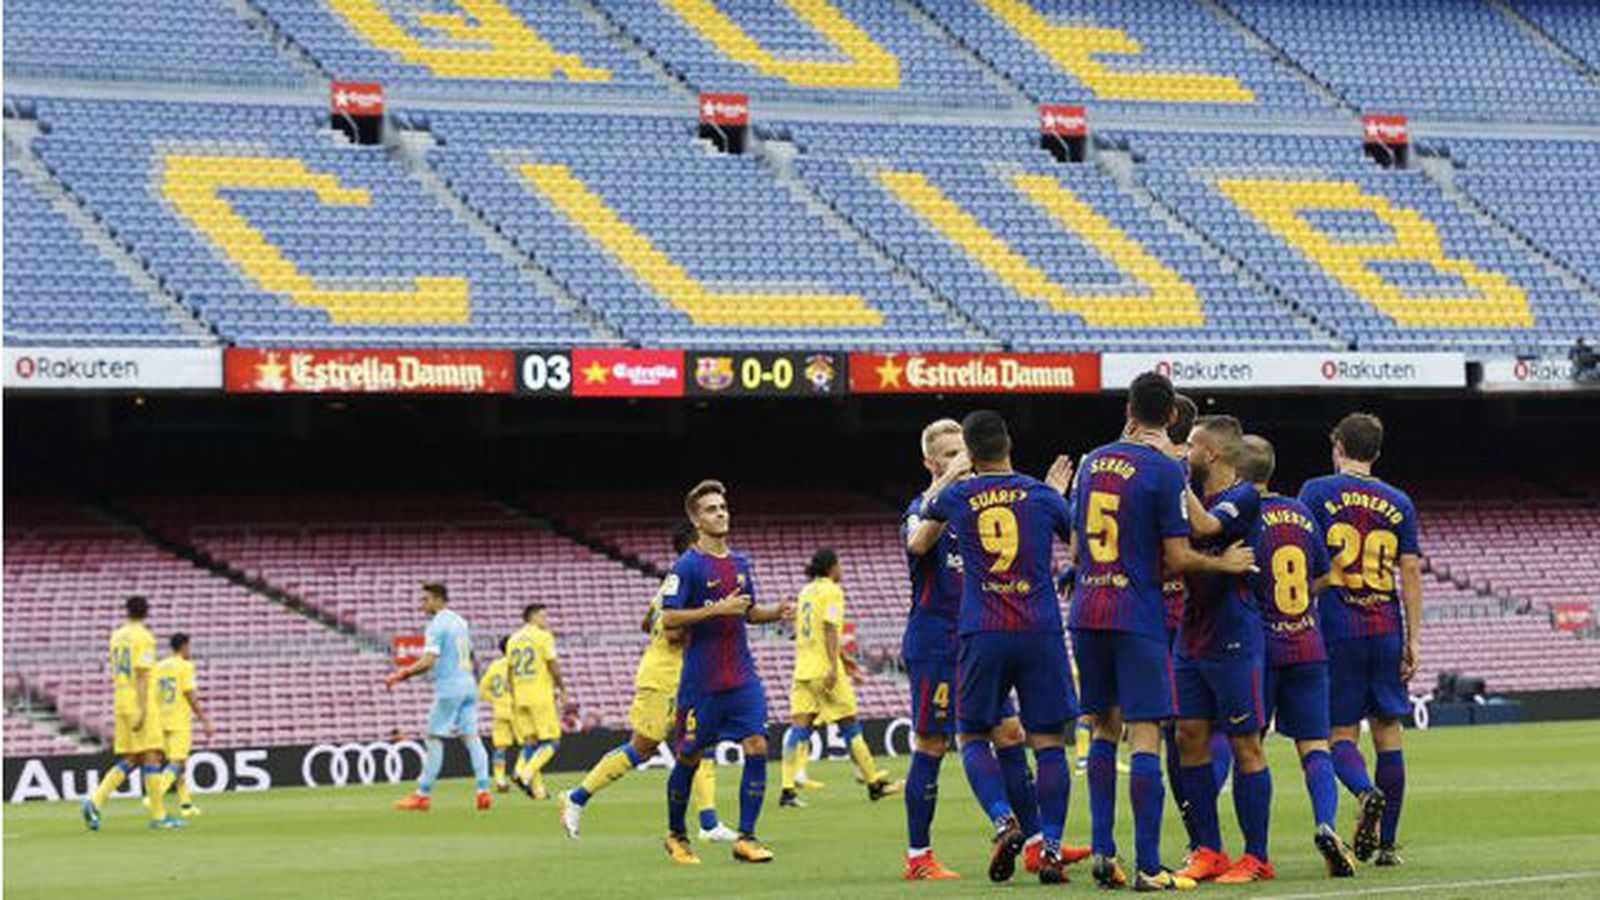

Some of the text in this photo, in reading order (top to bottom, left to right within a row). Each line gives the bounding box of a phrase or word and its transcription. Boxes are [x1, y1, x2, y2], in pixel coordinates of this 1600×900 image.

[38, 356, 139, 379] Rakuten
[289, 352, 484, 390] Estrella Damm
[522, 355, 571, 391] 03
[740, 358, 793, 390] 0-0
[906, 356, 1075, 389] Estrella Damm
[1173, 360, 1253, 380] Rakuten
[1338, 360, 1416, 380] Rakuten
[1530, 361, 1576, 380] Raku
[978, 506, 1019, 573] 9
[1086, 491, 1121, 563] 5
[1326, 522, 1399, 592] 20
[1271, 544, 1309, 617] 8
[512, 646, 536, 676] 22
[933, 682, 949, 708] 4
